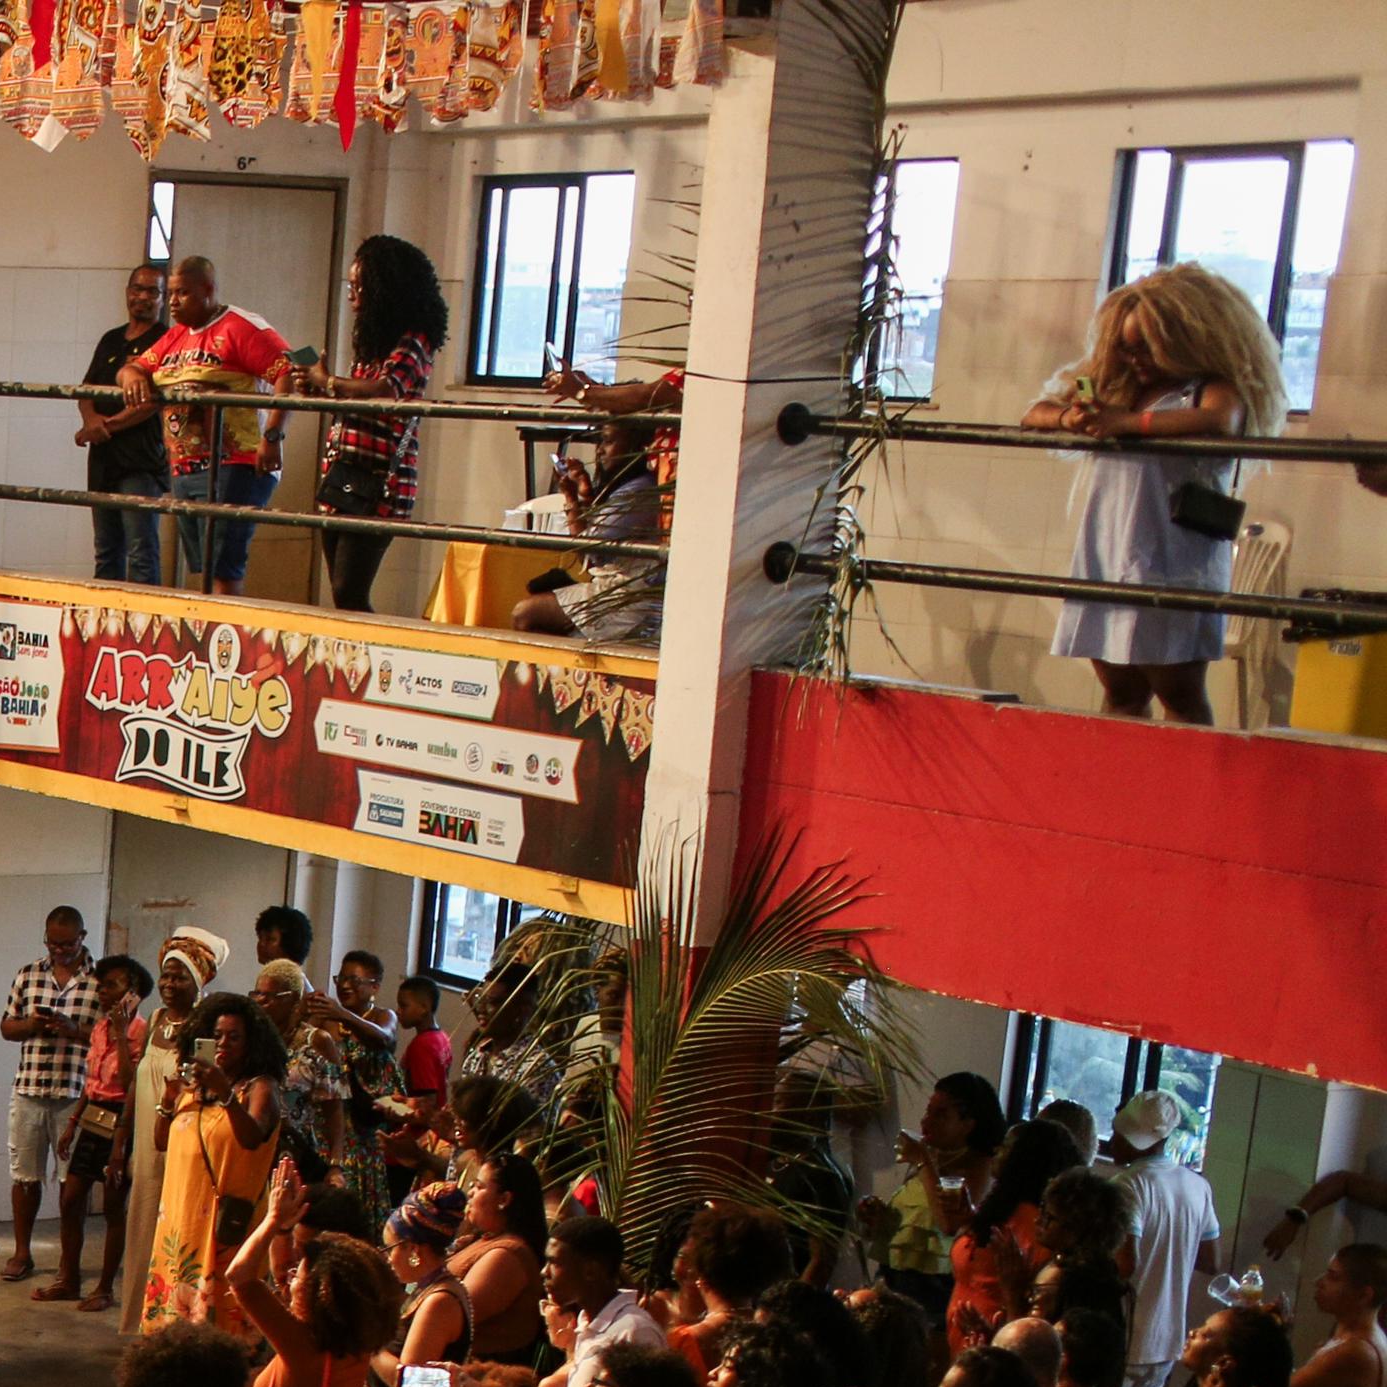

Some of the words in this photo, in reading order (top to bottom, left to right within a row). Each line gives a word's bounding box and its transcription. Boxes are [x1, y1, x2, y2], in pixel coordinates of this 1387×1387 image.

[18, 631, 49, 648] BAHIA
[415, 677, 442, 689] ACTOS
[1, 697, 39, 717] BAHIA
[134, 727, 170, 767] DO
[385, 737, 394, 747] TV
[396, 739, 418, 751] BAHIA
[545, 761, 563, 779] sbt
[420, 800, 448, 814] GOVERNO
[449, 806, 458, 815] DO
[459, 808, 481, 820] ESTADO
[419, 810, 479, 845] BAHIA
